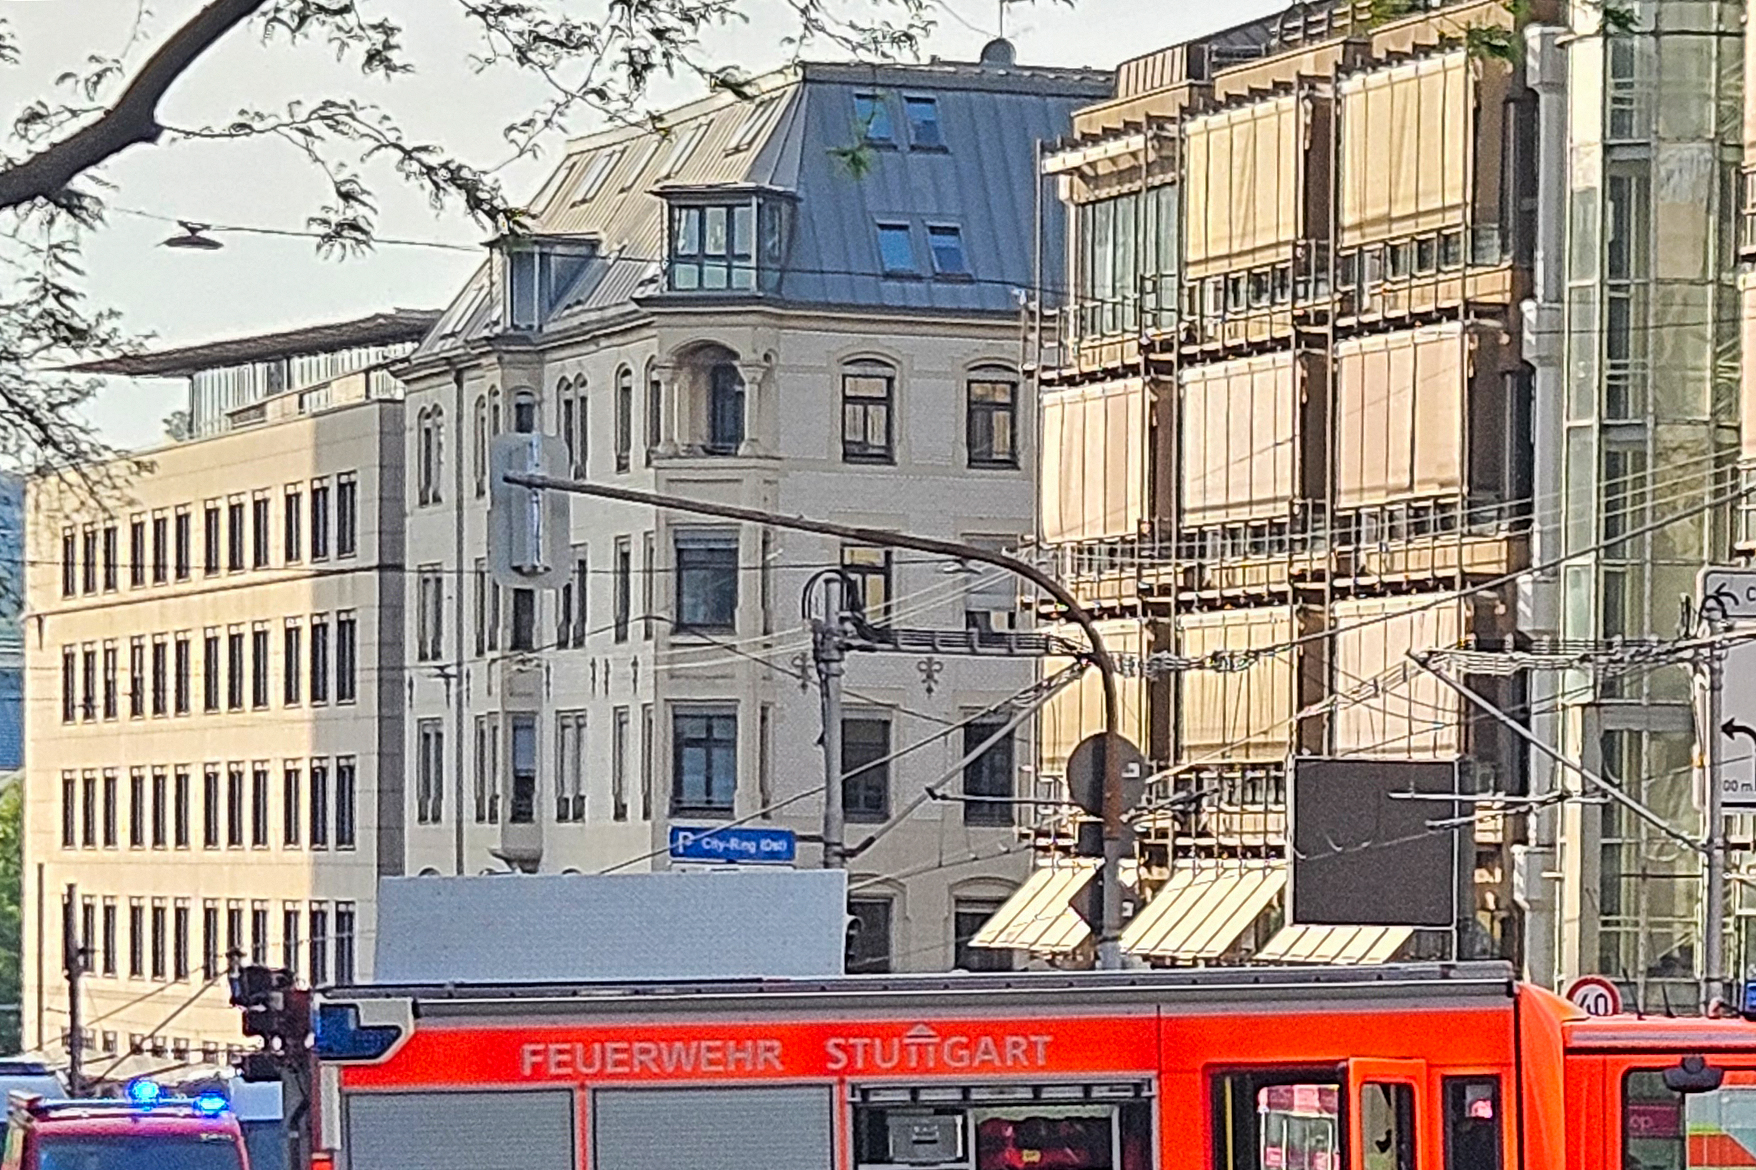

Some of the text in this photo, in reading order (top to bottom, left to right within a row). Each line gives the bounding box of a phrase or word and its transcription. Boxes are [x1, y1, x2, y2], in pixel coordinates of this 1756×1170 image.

[1579, 992, 1610, 1016] 40
[521, 1029, 1055, 1077] FEUERWEHR STUTTGART
